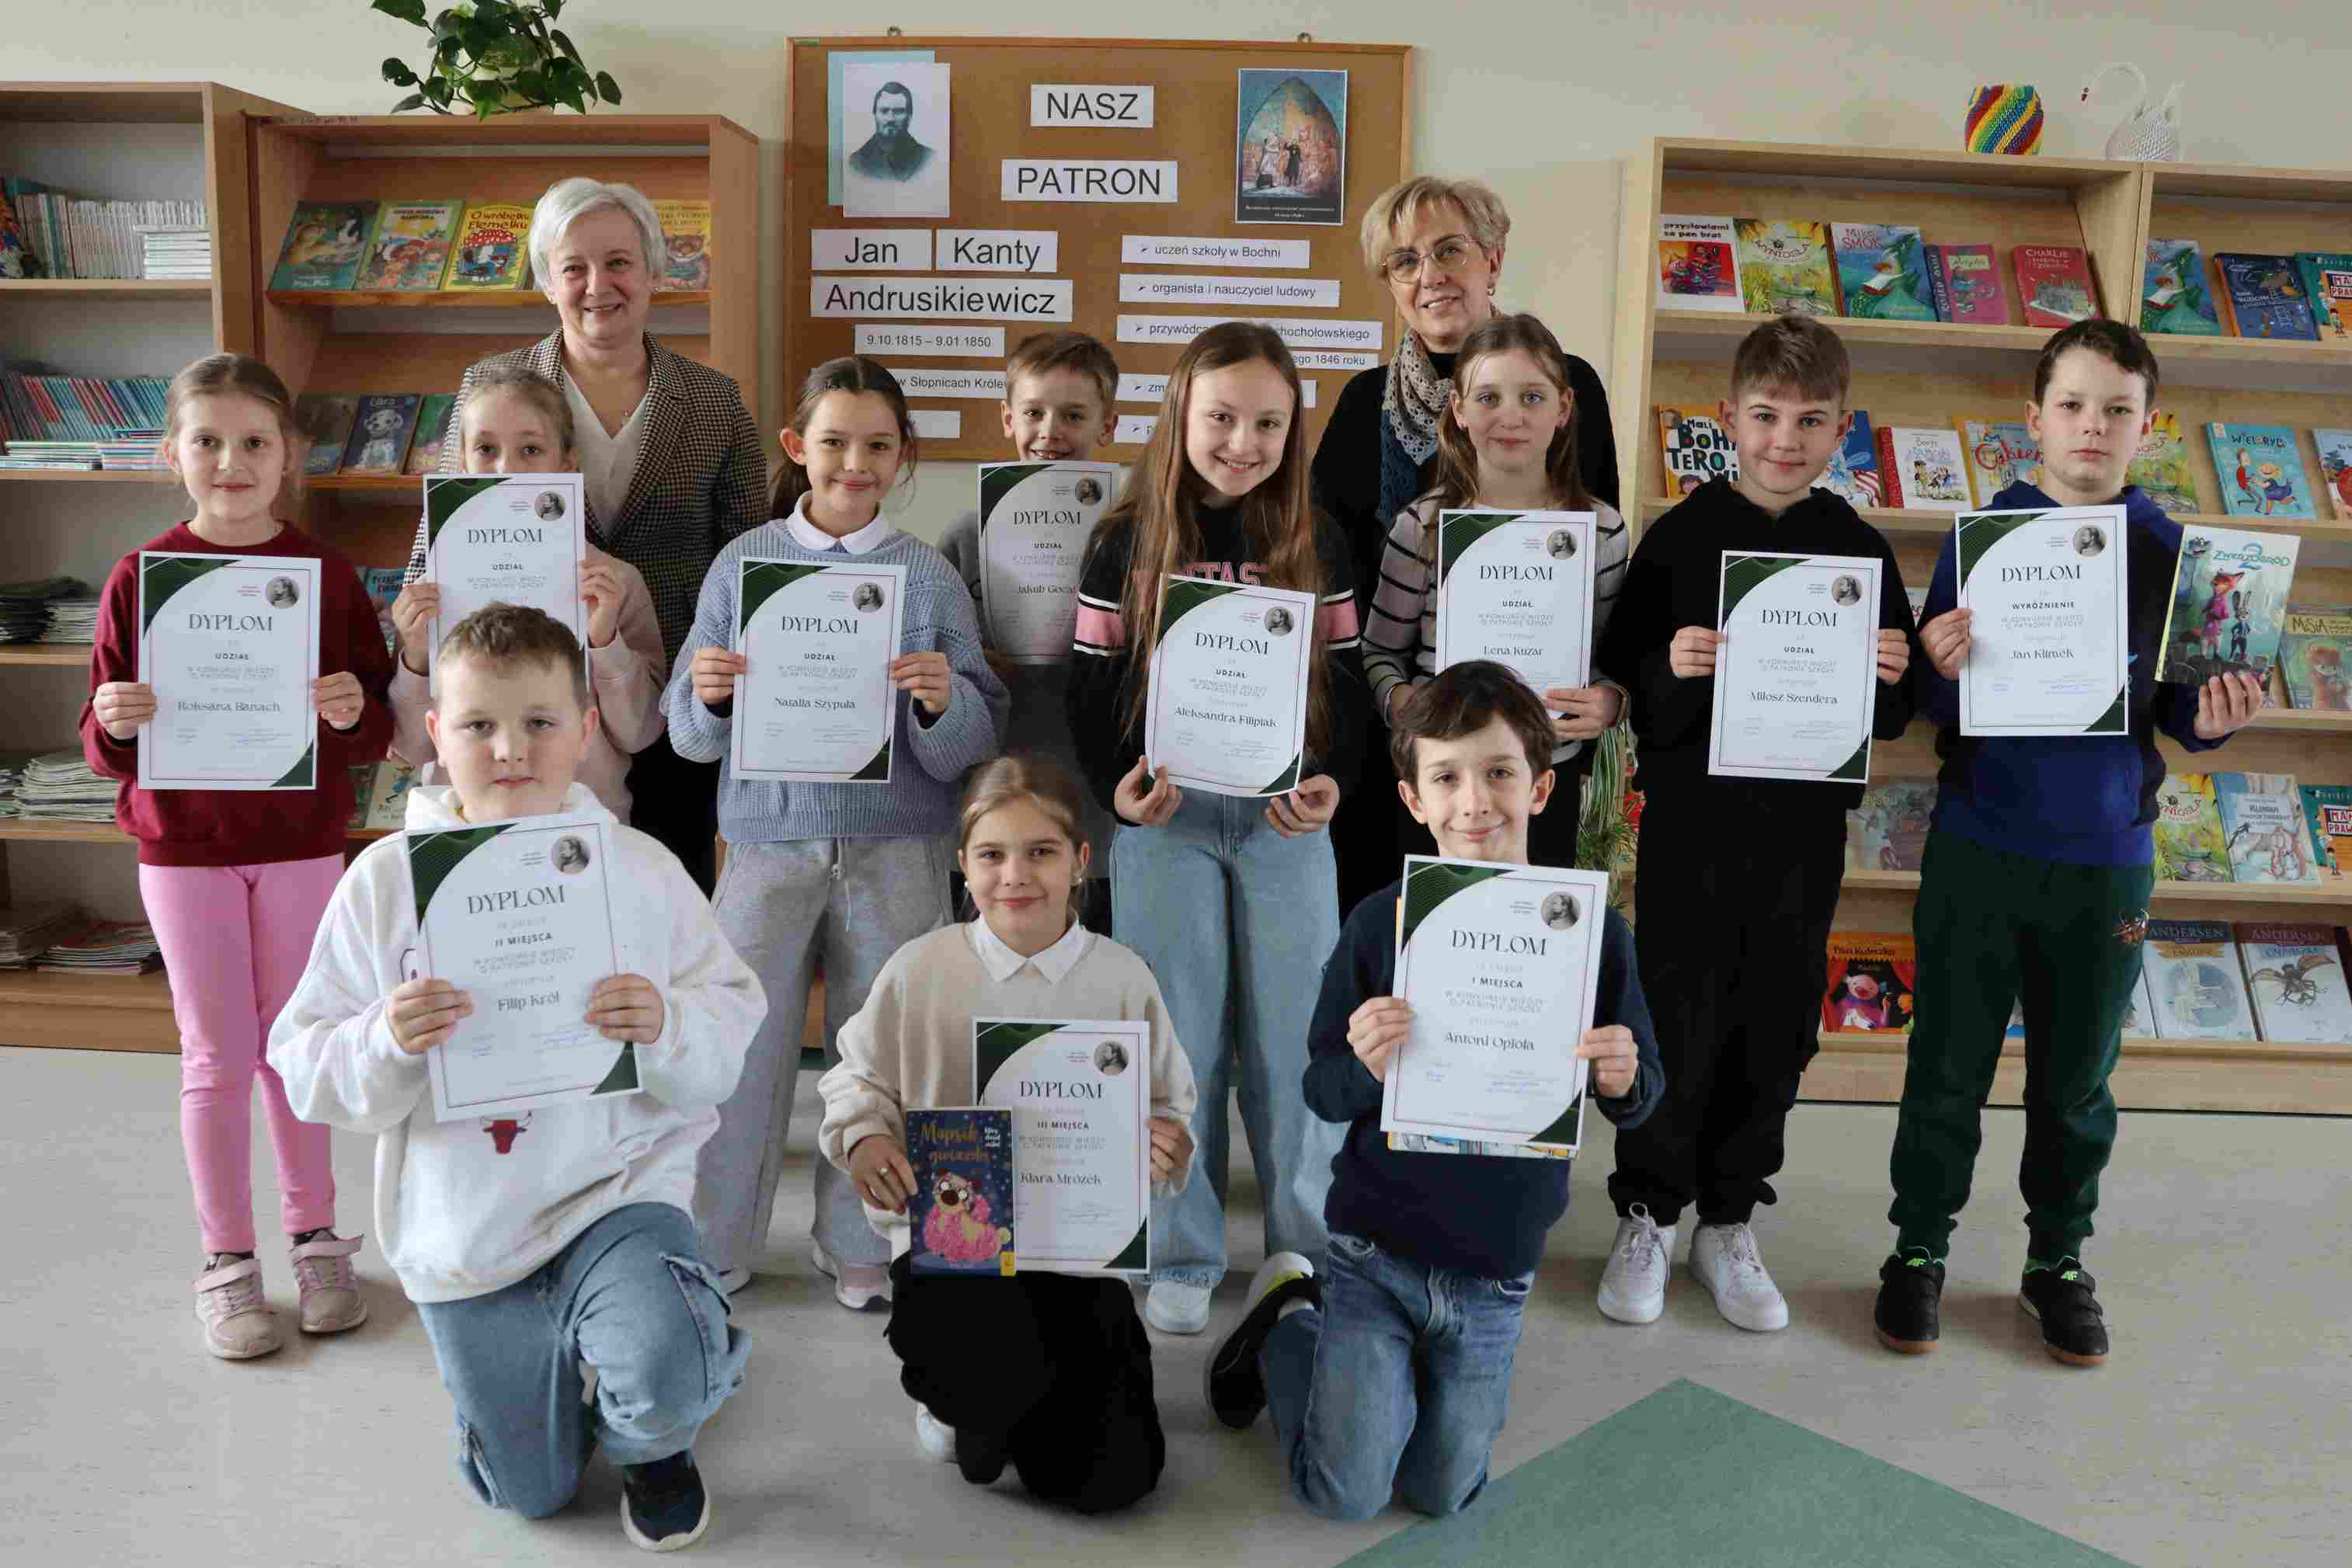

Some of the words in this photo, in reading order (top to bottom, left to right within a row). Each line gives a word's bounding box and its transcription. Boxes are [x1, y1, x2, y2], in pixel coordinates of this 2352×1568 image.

[1047, 92, 1139, 120] NASZ
[1018, 167, 1160, 195] PATRON
[844, 237, 899, 264] Jan
[953, 236, 1042, 272] Kanty
[1154, 245, 1189, 256] uczeń
[1192, 245, 1229, 259] szkoły
[1242, 245, 1282, 259] Bochni
[824, 283, 1056, 315] Andrusikiewicz
[1152, 283, 1205, 297] organista
[1208, 284, 1212, 294] i
[1214, 283, 1274, 298] nauczyciel
[1276, 286, 1317, 300] ludowy
[866, 335, 923, 346] 9.10.1815
[1276, 325, 1370, 342] hochołowskiego
[1316, 354, 1341, 365] 1846
[1342, 356, 1366, 366] roku
[910, 377, 971, 392] Słopnicach
[1013, 509, 1082, 526] DYPLOM
[467, 528, 544, 544] DYPLOM
[1479, 565, 1554, 582] DYPLOM
[2001, 564, 2082, 582] DYPLOM
[1501, 600, 1534, 608] UDZIAŁ
[188, 614, 273, 631] DYPLOM
[781, 616, 859, 635] DYPLOM
[1761, 608, 1838, 628] DYPLOM
[1194, 632, 1269, 656] DYPLOM
[1482, 645, 1511, 655] Lena
[1783, 645, 1815, 654] UDZIAŁ
[803, 652, 837, 662] UDZIAŁ
[1215, 668, 1247, 679] UDZIAŁ
[235, 701, 281, 713] Banach
[774, 697, 812, 709] Natalia
[1786, 693, 1839, 704] Szendera
[1174, 705, 1237, 723] Aleksandra
[1239, 713, 1279, 728] Filipiak
[467, 884, 567, 914] DYPLOM
[2150, 925, 2225, 938] ANDERSEN
[494, 939, 503, 949] II
[507, 932, 554, 946] MIEJSCA
[1451, 929, 1547, 958] DYPLOM
[1479, 976, 1523, 989] MIEJSCA
[498, 996, 527, 1012] Filip
[530, 990, 560, 1007] Król
[1444, 1031, 1489, 1048] Antoni
[1019, 1080, 1104, 1100] DYPLOM
[1051, 1121, 1090, 1131] MIEJSCA
[1019, 1173, 1053, 1184] Klara
